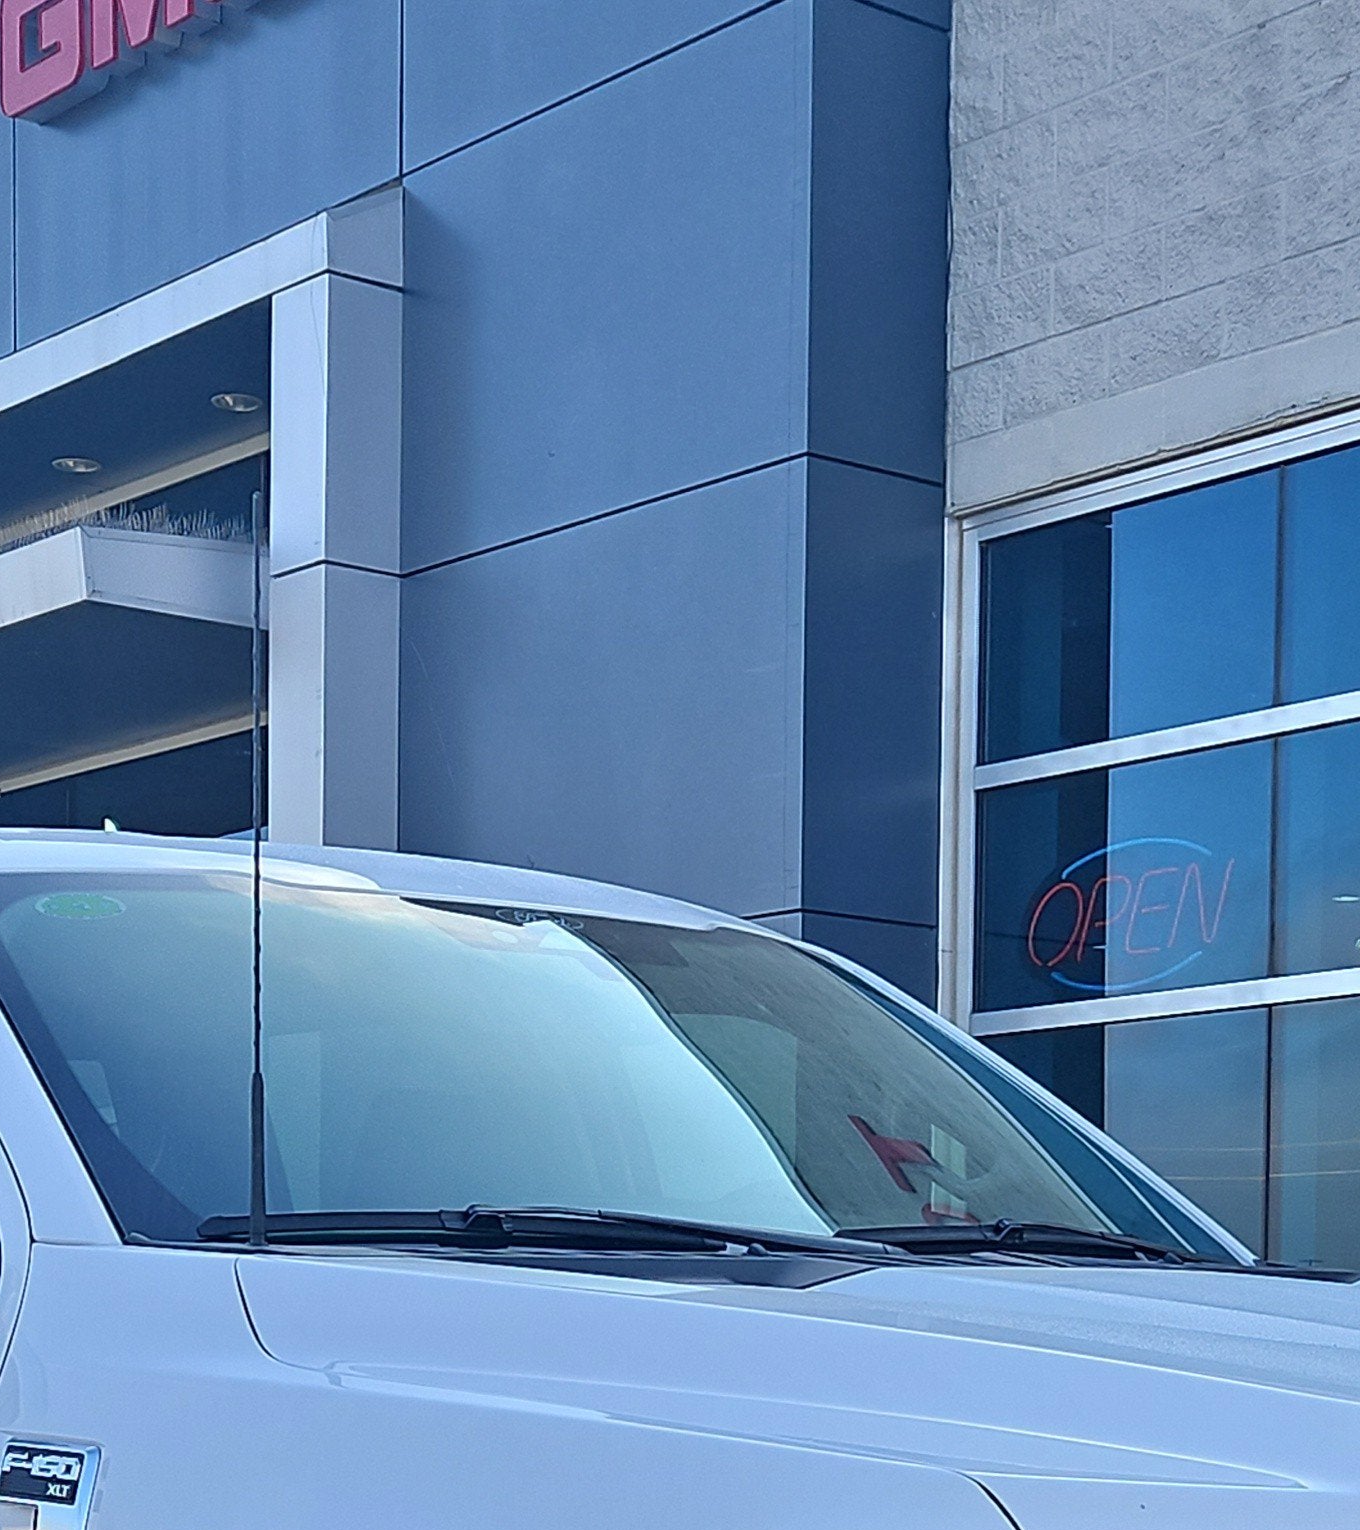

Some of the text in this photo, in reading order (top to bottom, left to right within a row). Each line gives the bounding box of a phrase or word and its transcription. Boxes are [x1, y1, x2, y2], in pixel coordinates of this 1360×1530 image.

[1028, 858, 1235, 967] OPEN
[1, 1452, 81, 1481] F-150
[46, 1482, 71, 1497] XLT
